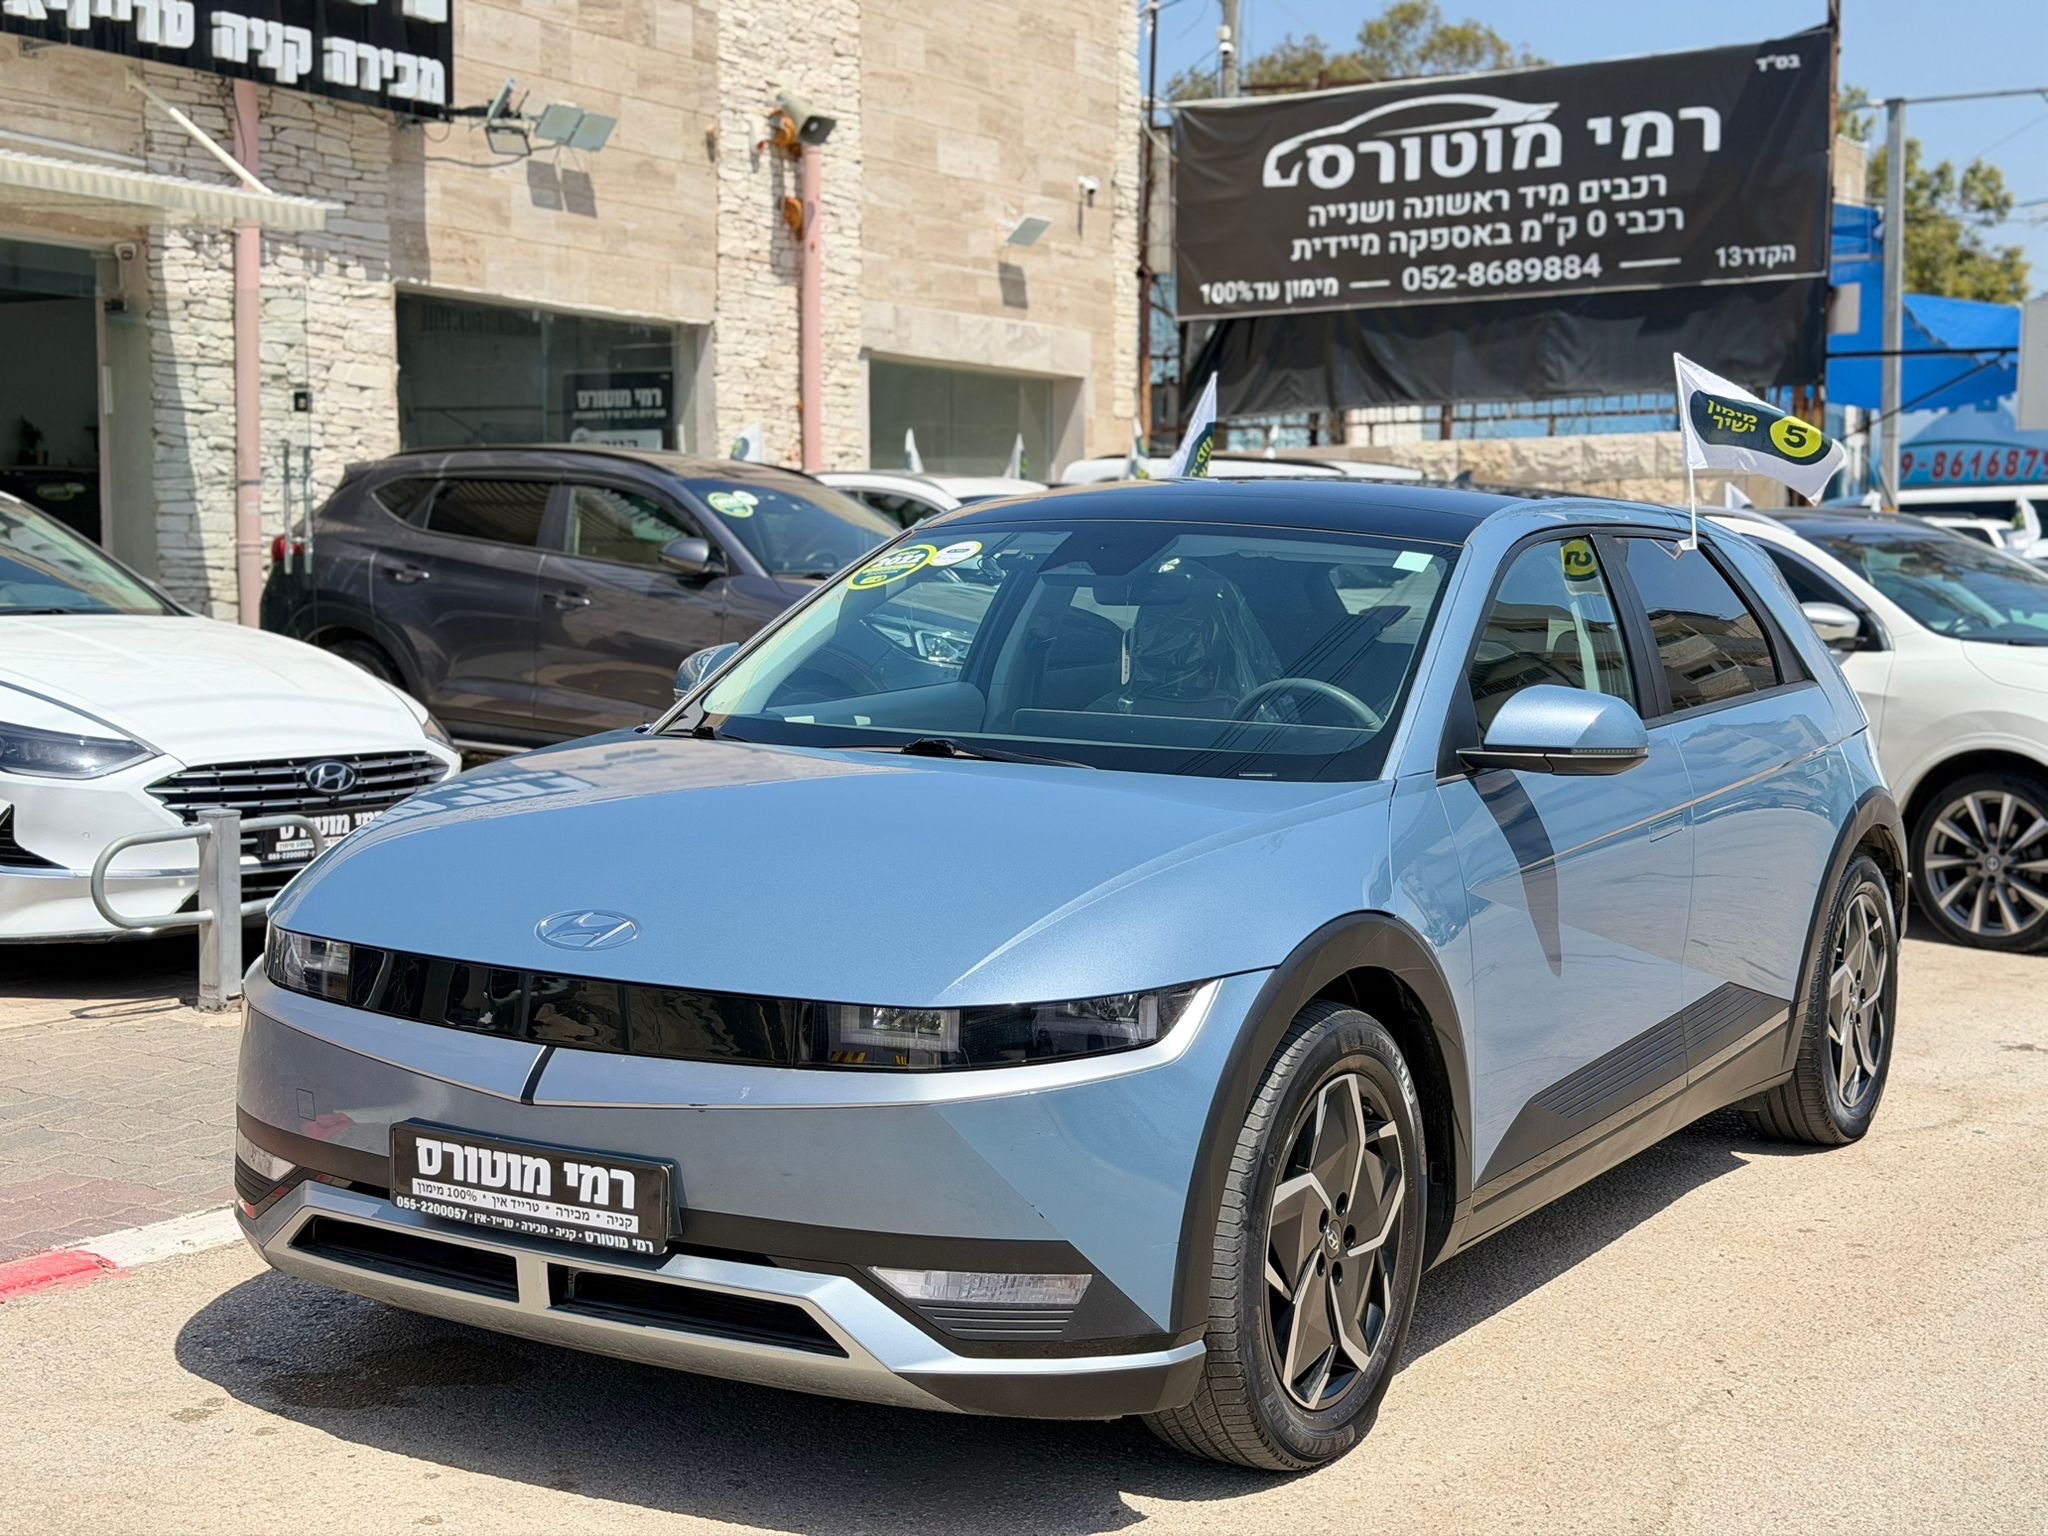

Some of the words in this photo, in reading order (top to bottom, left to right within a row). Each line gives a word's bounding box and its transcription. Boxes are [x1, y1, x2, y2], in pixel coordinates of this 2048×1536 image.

[211, 11, 313, 84] קניה
[323, 37, 445, 104] מכירה
[1587, 106, 1721, 160] רמי
[1306, 122, 1562, 189] מוטורס
[1517, 182, 1570, 209] מיד
[1579, 174, 1667, 204] רכבים
[1308, 199, 1395, 228] ושנייה
[1404, 188, 1510, 220] ראשונה
[1587, 210, 1607, 237] 0
[1615, 207, 1684, 235] רכבי
[1290, 232, 1381, 261] מיידית
[1389, 221, 1512, 258] באספקה
[1401, 253, 1602, 292] 052-8689884
[1285, 277, 1339, 304] מימון
[634, 387, 662, 407] רמי
[1707, 399, 1758, 423] מימון
[1713, 415, 1756, 433] ישיר
[1783, 425, 1808, 449] 5
[1901, 448, 2048, 480] 9-861687
[415, 1137, 551, 1196] מוטורס
[417, 1181, 444, 1196] מימון
[447, 1187, 477, 1202] 100%
[564, 1162, 635, 1210] רמי
[396, 1196, 467, 1220] 055-2200057
[491, 1195, 508, 1209] אין
[510, 1198, 540, 1212] טרייד
[555, 1205, 590, 1221] מכירה
[473, 1212, 514, 1228] טרייד-אין
[521, 1220, 548, 1235] מכירה
[555, 1226, 576, 1241] קניה
[606, 1213, 633, 1228] קניה
[584, 1231, 628, 1249] מוטורס
[632, 1239, 653, 1253] רמי
